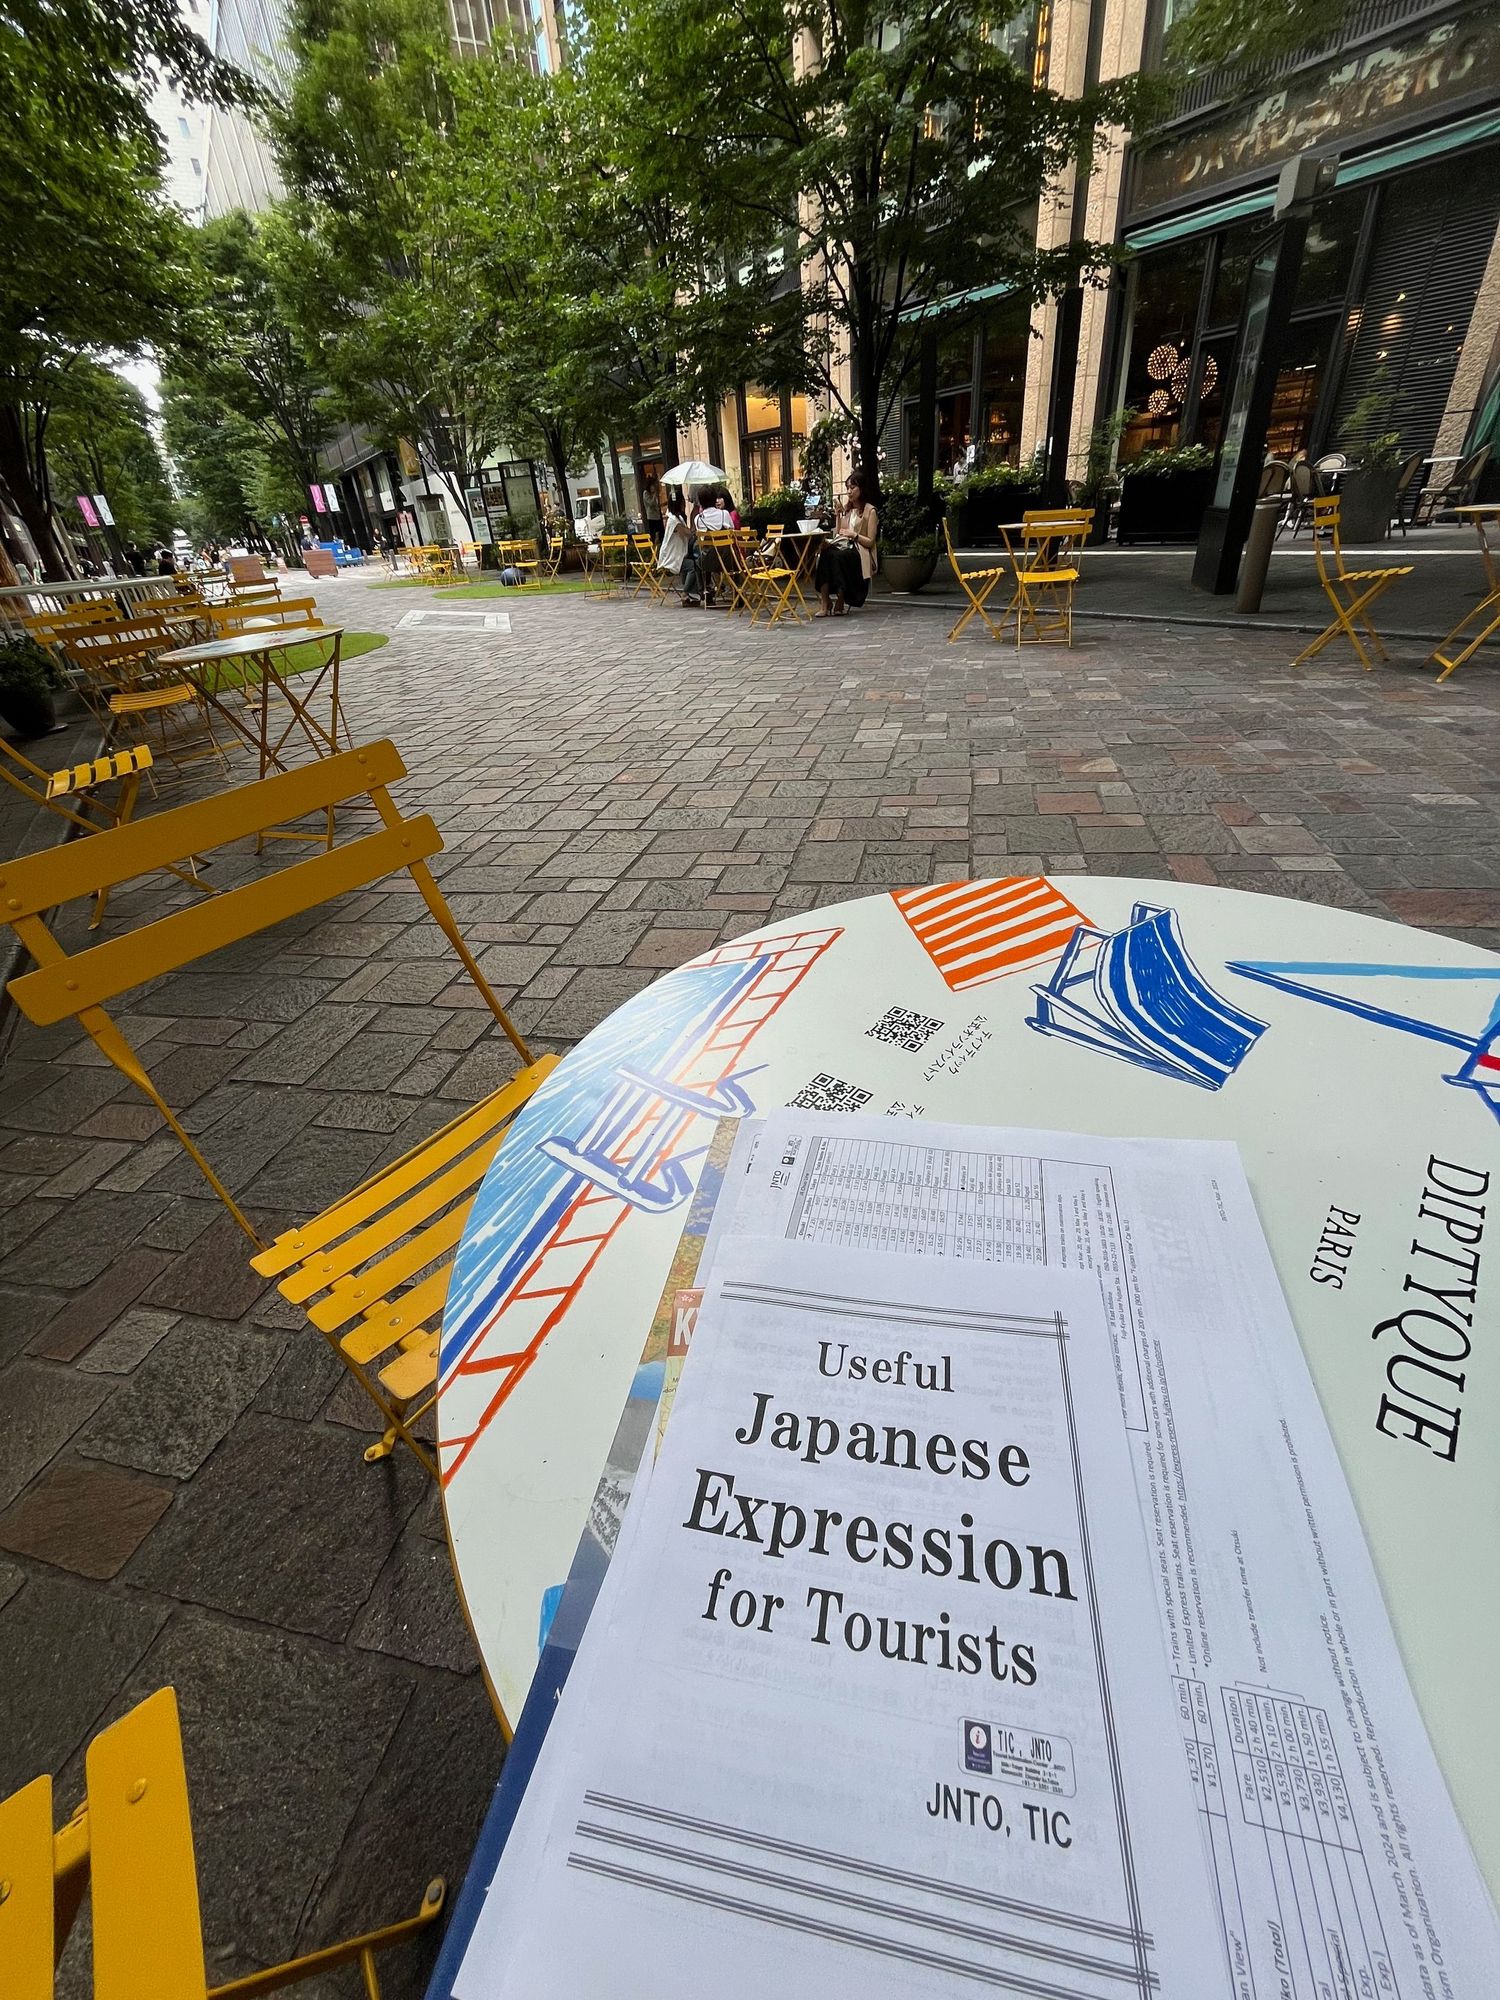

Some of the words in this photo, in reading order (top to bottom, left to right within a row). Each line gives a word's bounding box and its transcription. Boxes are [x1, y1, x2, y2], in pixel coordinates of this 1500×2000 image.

[923, 1015, 988, 1081] 公式オンラインストア
[769, 1170, 782, 1190] JNTO
[1310, 1204, 1361, 1290] PARIS
[1133, 1283, 1141, 1293] yen
[1371, 1154, 1490, 1463] DIPTYQUE
[1137, 1319, 1145, 1329] 200
[1138, 1329, 1146, 1337] of
[1141, 1338, 1150, 1359] charges
[818, 1341, 955, 1392] Useful
[1114, 1355, 1123, 1372] please
[1143, 1360, 1155, 1390] additional
[1148, 1391, 1157, 1405] with
[1152, 1406, 1160, 1419] cars
[735, 1392, 1031, 1487] Japanese
[1154, 1420, 1163, 1439] some
[1278, 1418, 1297, 1456] prohibited.
[1143, 1440, 1154, 1473] required.
[1156, 1440, 1164, 1451] for
[1291, 1455, 1298, 1463] is
[1157, 1451, 1170, 1483] required
[1293, 1464, 1312, 1507] permission
[1150, 1482, 1162, 1527] reservation
[1163, 1493, 1177, 1538] reservation
[682, 1468, 1078, 1601] Expression
[1155, 1528, 1165, 1547] Seat
[1178, 1503, 1195, 1566] recommended.
[1305, 1508, 1319, 1539] written
[1171, 1540, 1181, 1560] Seat
[1231, 1530, 1242, 1555] Otsuki
[1159, 1549, 1168, 1574] seats.
[1237, 1556, 1244, 1565] at
[1313, 1540, 1328, 1575] without
[1175, 1561, 1185, 1589] trains.
[1239, 1567, 1248, 1585] time
[1323, 1578, 1336, 1597] part
[1160, 1573, 1174, 1607] special
[1191, 1577, 1206, 1629] reservation
[1242, 1587, 1255, 1621] transfer
[1329, 1599, 1337, 1609] in
[1166, 1608, 1176, 1629] with
[1179, 1591, 1191, 1626] Express
[1331, 1610, 1340, 1621] or
[701, 1568, 784, 1633] for
[806, 1587, 1038, 1686] Tourists
[1250, 1623, 1263, 1654] include
[1320, 1612, 1333, 1645] notice.
[1335, 1623, 1350, 1654] whole
[1170, 1631, 1181, 1660] Trains
[1183, 1628, 1197, 1664] Limited
[1258, 1656, 1267, 1673] Not
[1327, 1647, 1345, 1687] without
[1344, 1656, 1354, 1667] in
[1177, 1679, 1187, 1703] min.
[1194, 1683, 1205, 1707] min.
[1348, 1669, 1377, 1741] Reproduction
[1180, 1705, 1190, 1720] 60
[1196, 1709, 1207, 1724] 60
[1229, 1696, 1244, 1744] Duration
[1244, 1694, 1256, 1719] min.
[1263, 1698, 1273, 1722] min.
[1279, 1702, 1291, 1726] min.
[1297, 1706, 1309, 1730] min.
[1340, 1689, 1358, 1729] change
[1248, 1720, 1258, 1734] 40
[1265, 1724, 1277, 1737] 10
[1283, 1728, 1295, 1742] 00
[1315, 1710, 1327, 1734] min.
[1030, 1736, 1053, 1763] JNTO
[1252, 1736, 1261, 1744] h
[1301, 1732, 1313, 1746] 50
[1319, 1737, 1331, 1751] 55
[1353, 1731, 1363, 1743] to
[1202, 1745, 1217, 1787] ¥1,570
[1306, 1749, 1316, 1757] h
[1256, 1758, 1272, 1801] ¥2,510
[1356, 1746, 1376, 1789] subject
[1370, 1744, 1395, 1800] reserved.
[1243, 1773, 1255, 1801] Fare
[1274, 1762, 1291, 1806] ¥3,530
[1293, 1766, 1310, 1812] ¥3,730
[1311, 1771, 1330, 1816] ¥3,930
[1330, 1775, 1349, 1821] ¥4,130
[1369, 1792, 1380, 1802] is
[926, 1782, 1011, 1838] JNTO,
[1023, 1803, 1073, 1849] TIC
[1372, 1805, 1388, 1830] and
[1388, 1802, 1407, 1840] rights
[1380, 1834, 1399, 1868] 2024
[1398, 1843, 1414, 1862] All
[1391, 1871, 1413, 1921] March
[1403, 1921, 1419, 1938] of
[1408, 1866, 1444, 1967] Organization.
[1267, 1920, 1289, 1975] (Total)
[1412, 1942, 1425, 1960] as
[1358, 1965, 1374, 1999] Exp.
[1419, 1964, 1436, 2000] data
